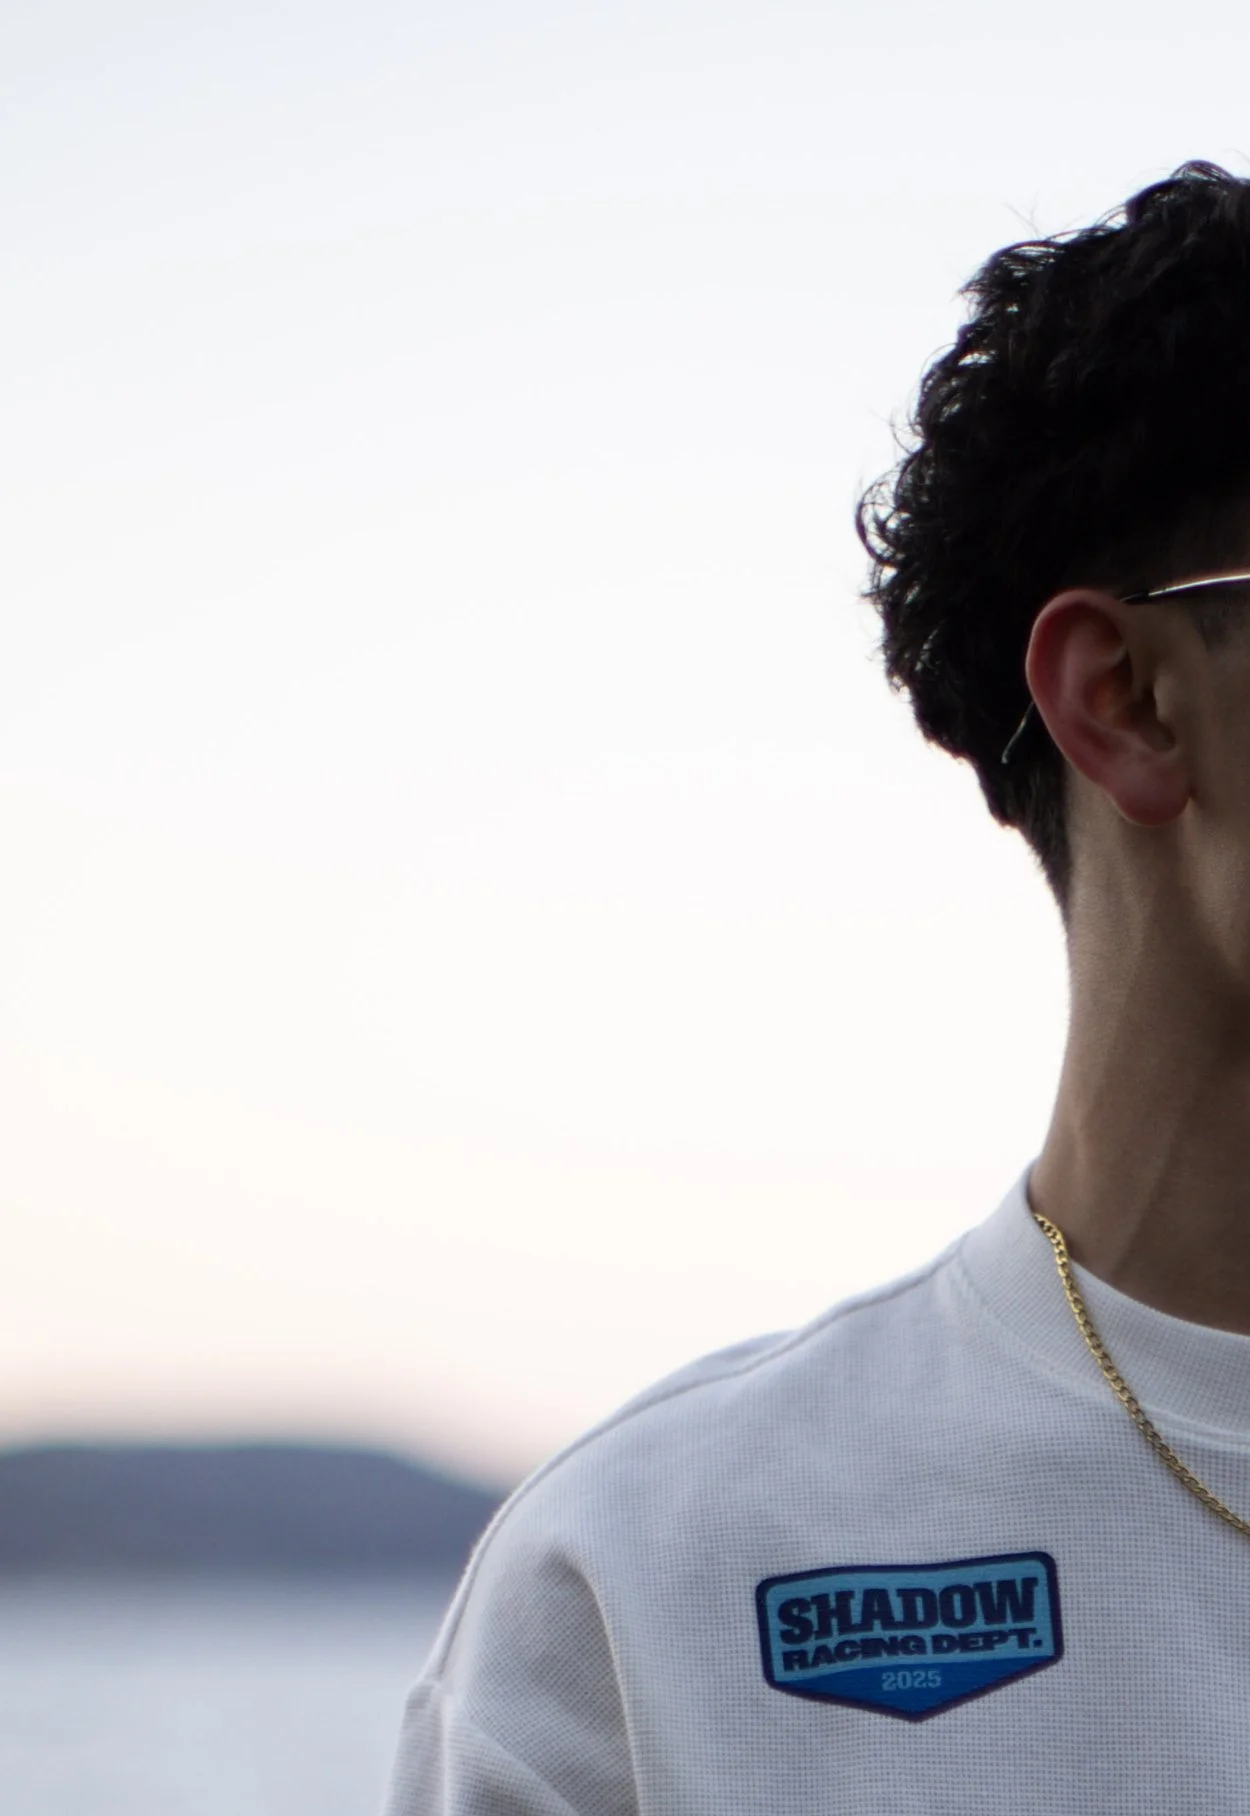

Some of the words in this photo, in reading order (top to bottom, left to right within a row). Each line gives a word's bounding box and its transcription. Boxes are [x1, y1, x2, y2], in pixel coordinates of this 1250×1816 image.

[776, 1576, 1039, 1646] SHADOW
[781, 1634, 927, 1673] RACING
[931, 1627, 1044, 1655] DEPT.
[880, 1668, 945, 1693] 2025
